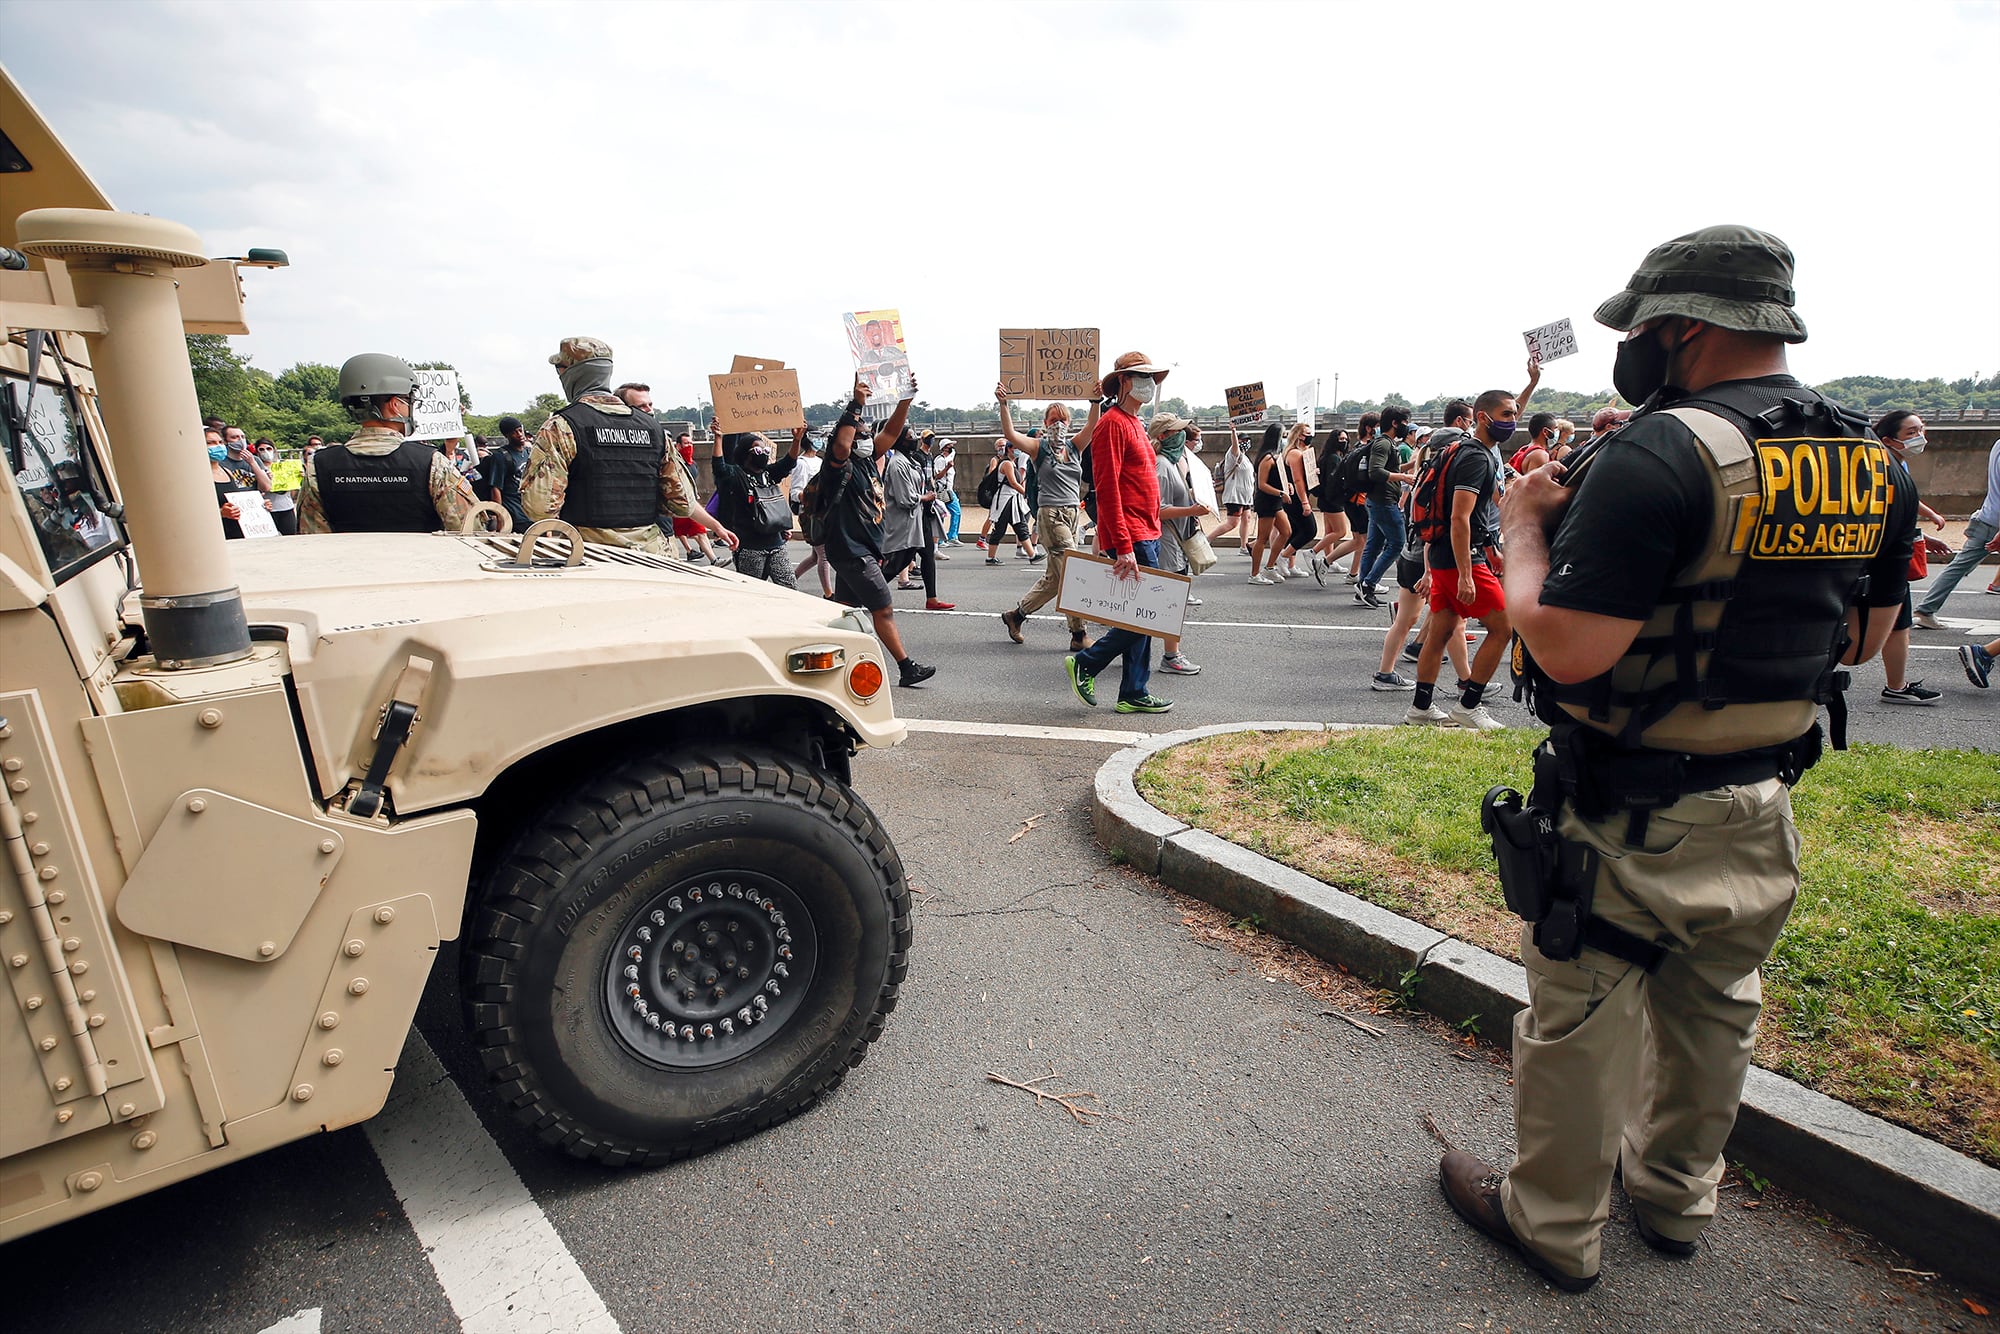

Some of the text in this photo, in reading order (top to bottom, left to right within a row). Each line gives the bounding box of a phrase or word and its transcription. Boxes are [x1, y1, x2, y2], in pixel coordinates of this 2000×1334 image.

[1041, 329, 1095, 346] JUSTICE
[1537, 322, 1569, 339] FLUSH
[1545, 335, 1573, 351] TURD
[1036, 347, 1097, 361] TOO LONG
[1546, 348, 1562, 361] NOV
[1046, 360, 1090, 372] DELAYED
[416, 372, 450, 387] ID YOU
[715, 375, 768, 391] WHEN DID
[1040, 371, 1093, 383] IS JUSTICE
[763, 390, 778, 400] AND
[1042, 384, 1084, 396] DENIED
[1239, 393, 1254, 402] CALL
[595, 428, 651, 445] NATIONAL GUARD
[1760, 443, 1885, 516] POLICE
[1106, 573, 1144, 600] ALL
[1080, 599, 1092, 608] for
[1136, 607, 1157, 620] and
[334, 618, 422, 632] NO STEP
